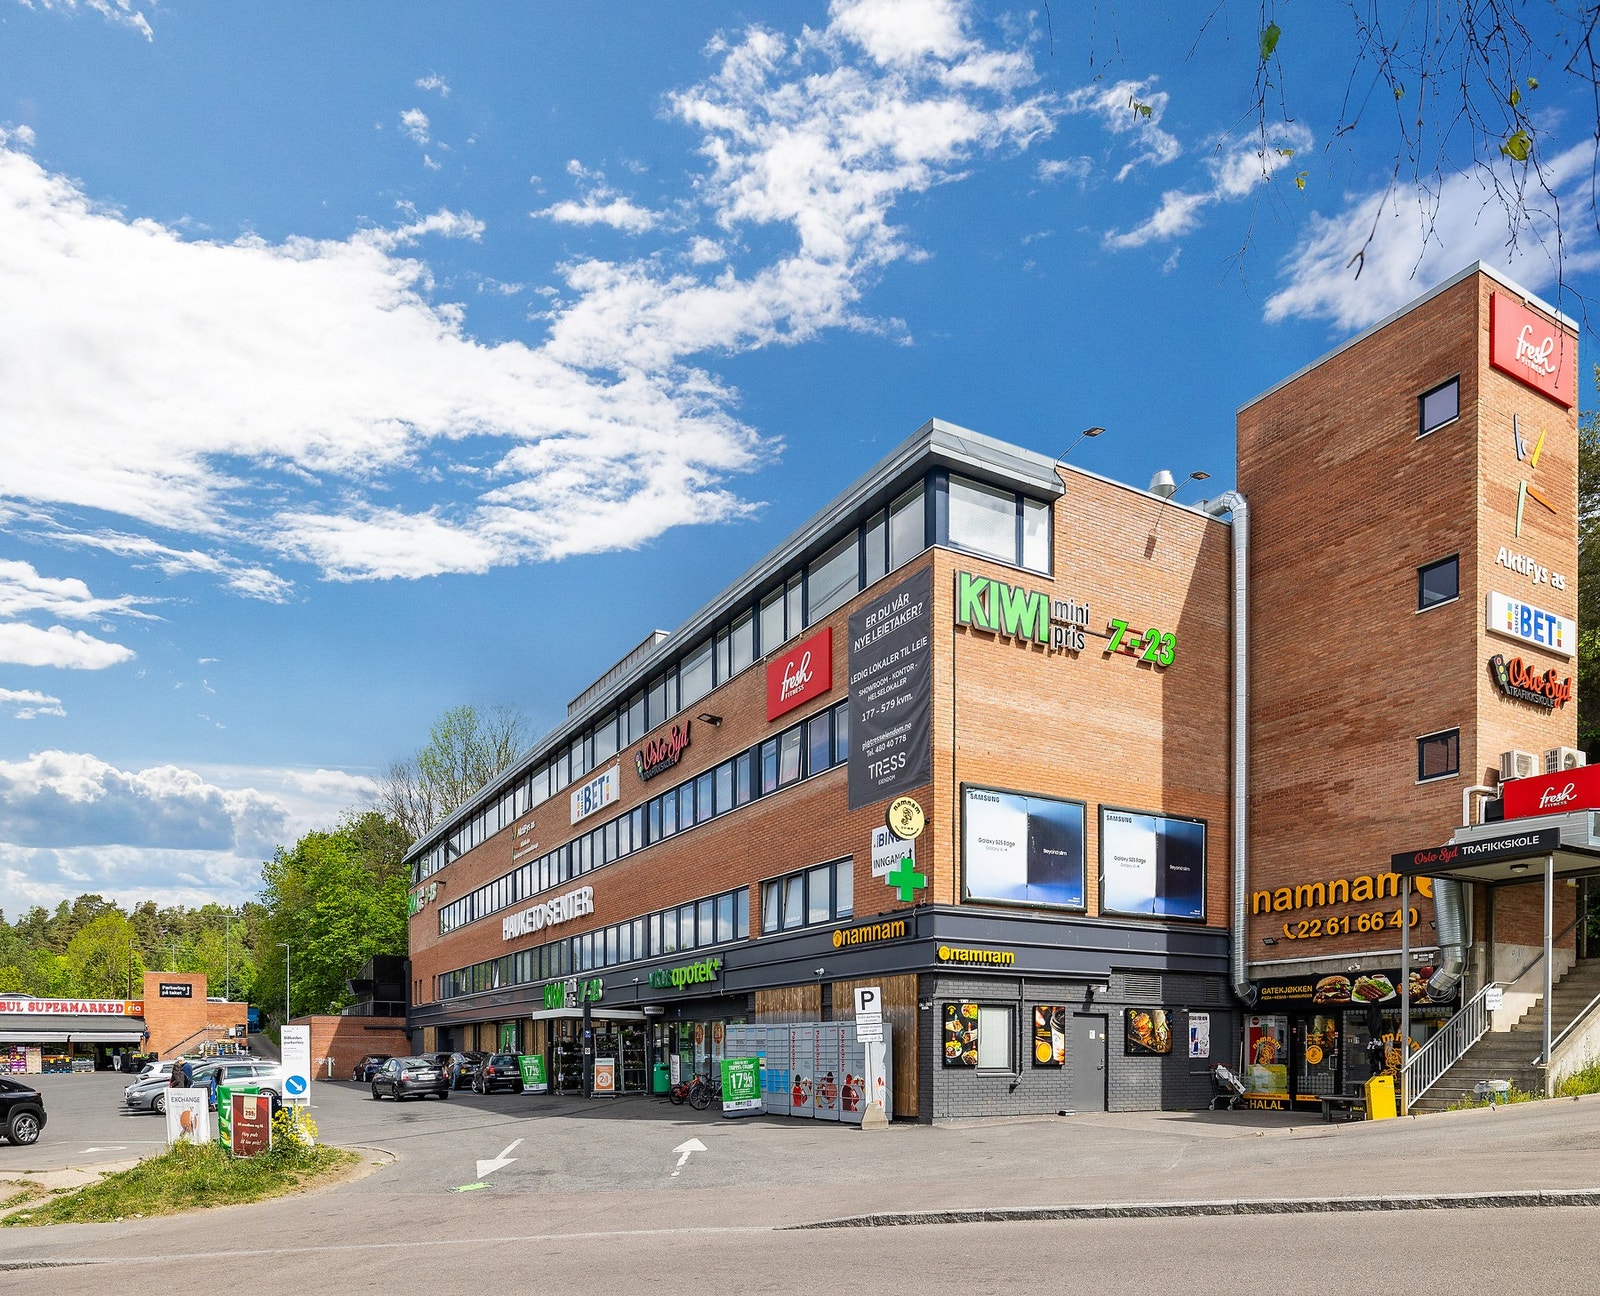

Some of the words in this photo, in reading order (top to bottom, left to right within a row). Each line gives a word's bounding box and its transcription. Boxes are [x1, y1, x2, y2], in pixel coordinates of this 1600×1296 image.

[1515, 324, 1556, 373] fresh
[1521, 356, 1545, 377] FITNESS
[1494, 546, 1548, 585] AktiFys
[1550, 571, 1565, 590] as
[866, 613, 877, 628] ER
[878, 604, 891, 620] DU
[892, 593, 910, 612] VÅR
[956, 570, 1050, 646] KIWI
[1054, 599, 1089, 625] mini
[854, 632, 871, 651] NYE
[872, 602, 923, 641] LEIETAKER?
[1054, 625, 1086, 651] pris
[1520, 604, 1556, 646] BET
[1107, 618, 1177, 667] 7-23
[850, 668, 868, 685] LEDIG
[869, 651, 900, 675] LOKALER
[901, 645, 911, 657] TIL
[912, 635, 928, 652] LEIE
[780, 651, 813, 702] fresh
[859, 675, 889, 697] SHOWROOM
[892, 664, 914, 679] KONTOR
[867, 677, 907, 702] HELSELOKALER
[1509, 656, 1545, 693] Oslo
[1545, 668, 1573, 709] Syd
[862, 708, 875, 722] 177
[881, 700, 896, 713] 579
[896, 693, 913, 707] kvm.
[643, 739, 667, 770] Oslo
[668, 719, 690, 763] Syd
[887, 740, 894, 749] 40
[895, 734, 907, 745] 778
[868, 752, 906, 780] TRESS
[584, 775, 605, 815] BET
[893, 799, 921, 815] namnam
[970, 793, 1000, 803] SAMSUNG
[1538, 782, 1578, 809] fresh
[1106, 814, 1133, 823] SAMSUNG
[978, 837, 995, 845] Galaxy
[1003, 840, 1015, 848] Edge
[1414, 851, 1438, 865] Oslo
[1439, 846, 1459, 863] Syd
[1461, 835, 1540, 856] TRAFIKKSKOLE
[502, 903, 548, 941] HAUKETO
[546, 886, 595, 927] SENTER
[1297, 919, 1322, 939] 22
[1326, 915, 1350, 936] 61
[1357, 911, 1385, 932] 66
[1389, 907, 1419, 928] 40
[842, 920, 906, 946] namnam
[950, 947, 1015, 964] namnam
[861, 991, 875, 1011] P
[1261, 985, 1313, 995] GATEKJØKKEN
[28, 1002, 124, 1014] SUPERMARKED
[127, 1004, 142, 1012] ria
[1252, 1036, 1281, 1050] namnam
[731, 1072, 753, 1089] 17%
[1249, 1099, 1285, 1110] HALAL
